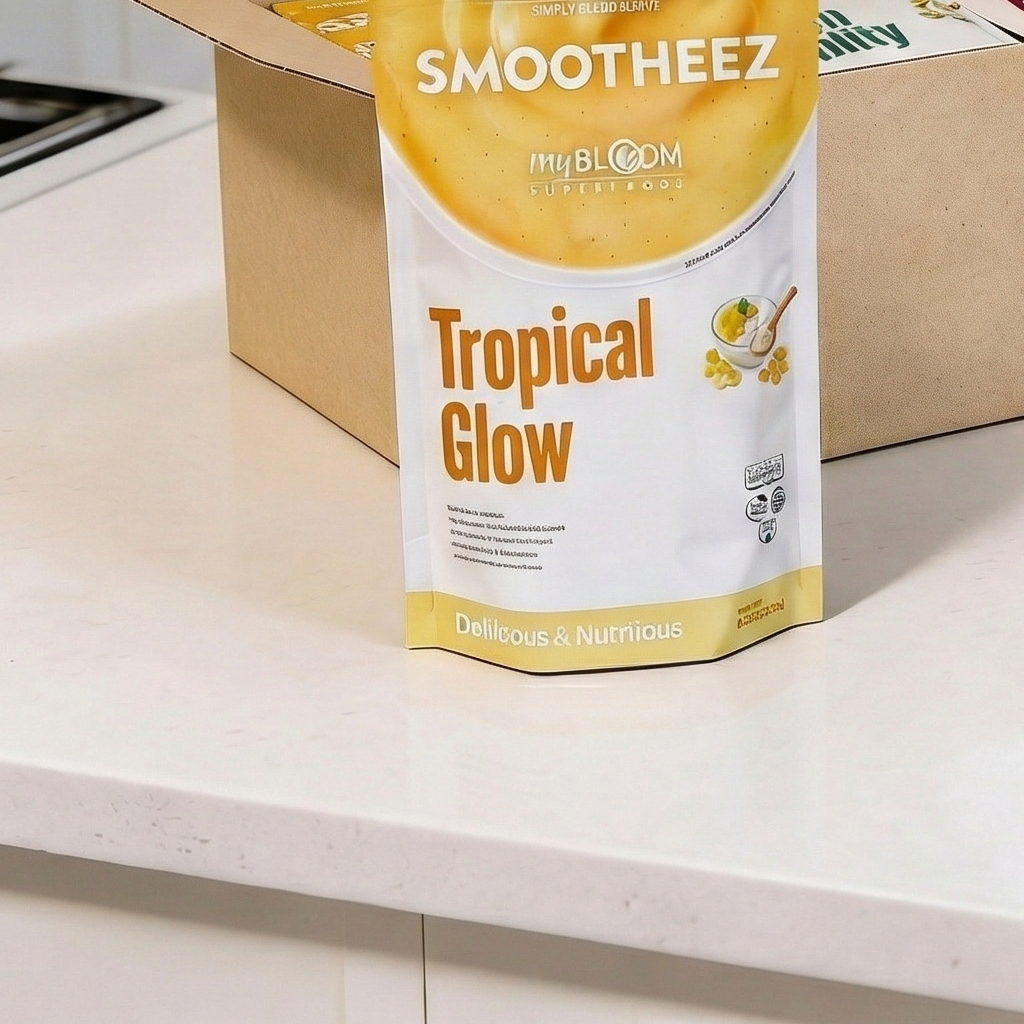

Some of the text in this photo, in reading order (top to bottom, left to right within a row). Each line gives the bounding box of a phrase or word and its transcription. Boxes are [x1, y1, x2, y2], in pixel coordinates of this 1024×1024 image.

[531, 2, 576, 17] SIMPLY
[415, 33, 780, 95] SMOOTHEEZ
[428, 297, 654, 410] Tropical
[440, 401, 574, 486] Glow
[552, 625, 572, 647] &
